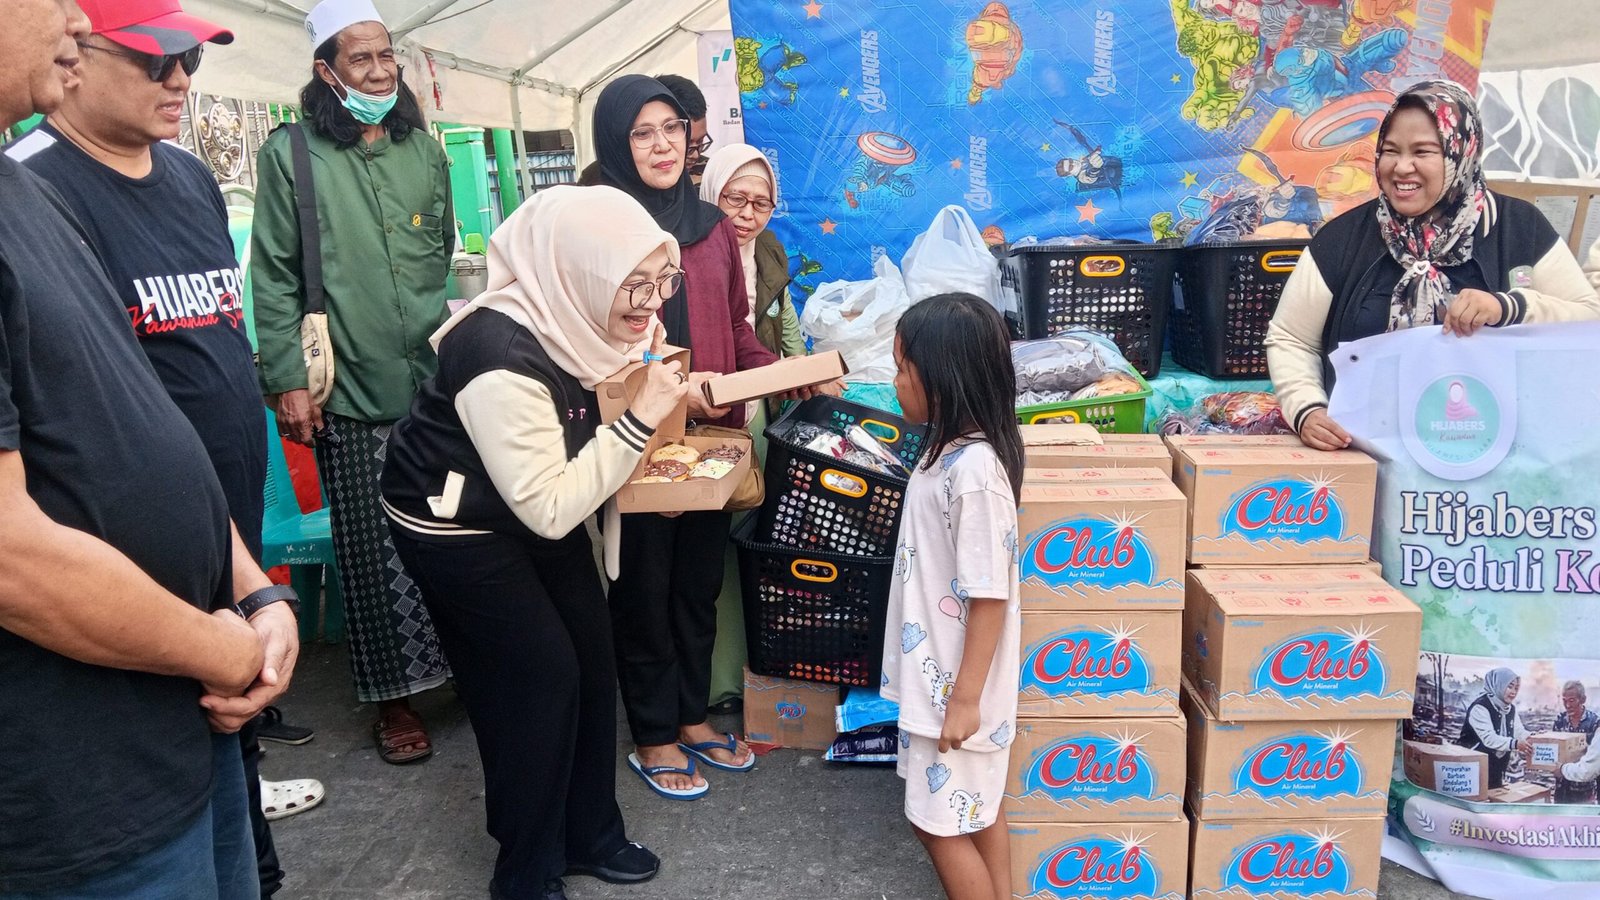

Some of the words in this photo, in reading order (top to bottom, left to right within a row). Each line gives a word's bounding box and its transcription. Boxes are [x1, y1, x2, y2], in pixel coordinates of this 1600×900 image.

[857, 29, 887, 114] AVENGERS
[1085, 9, 1117, 97] AVENGERS
[963, 135, 993, 213] AVENGERS
[1430, 420, 1486, 431] HIJABERS
[1236, 486, 1329, 530] Club
[1400, 491, 1597, 546] Hijabers
[1034, 526, 1135, 574] Club
[1400, 543, 1544, 593] Peduli
[1033, 638, 1132, 684] Club
[1270, 639, 1370, 686] Club
[1039, 744, 1138, 788] Club
[1250, 742, 1346, 787] Club
[1046, 846, 1141, 888] Club
[1238, 841, 1334, 883] Club
